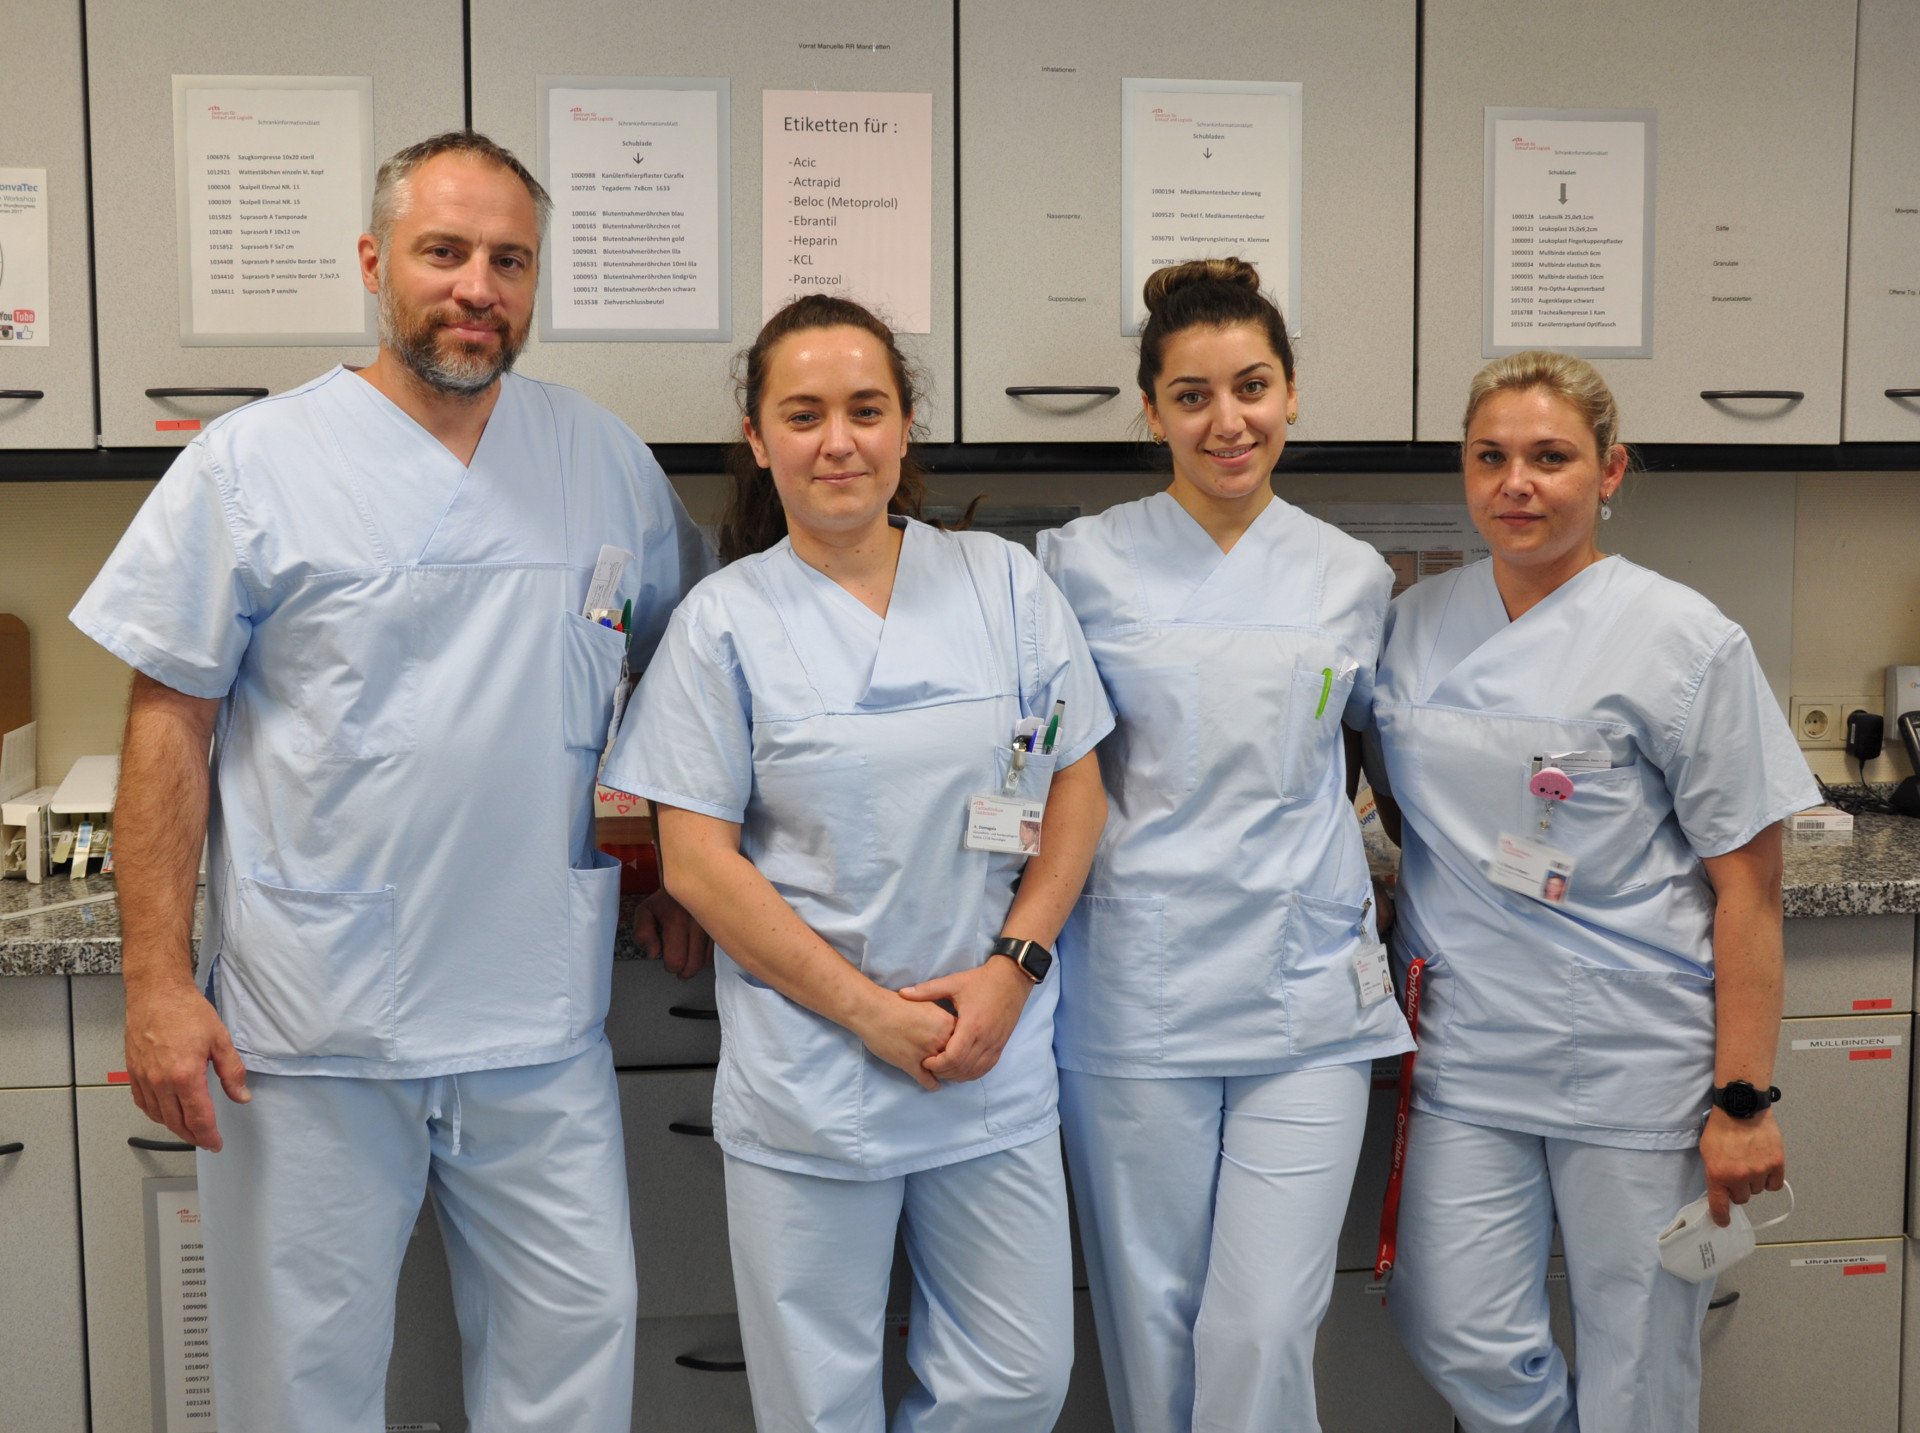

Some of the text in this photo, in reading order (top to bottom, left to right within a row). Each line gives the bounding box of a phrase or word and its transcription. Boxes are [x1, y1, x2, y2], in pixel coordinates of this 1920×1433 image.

[785, 117, 888, 133] Etiketten für
[789, 157, 816, 167] -Acic
[788, 177, 840, 189] -Actrapid
[3, 195, 36, 203] Workshop
[789, 196, 897, 210] -Beloc (Metoprolol)
[788, 216, 836, 226] -Ebrantil
[789, 235, 837, 247] -Heparin
[788, 255, 814, 265] -KCL
[789, 274, 841, 285] -Pantozol
[15, 311, 35, 322] Tube
[1407, 965, 1420, 1022] Optiplan
[1809, 1037, 1884, 1047] MULLBINDEN
[1394, 1113, 1405, 1169] Optiplan
[1805, 1256, 1869, 1265] Uhrglasverb.
